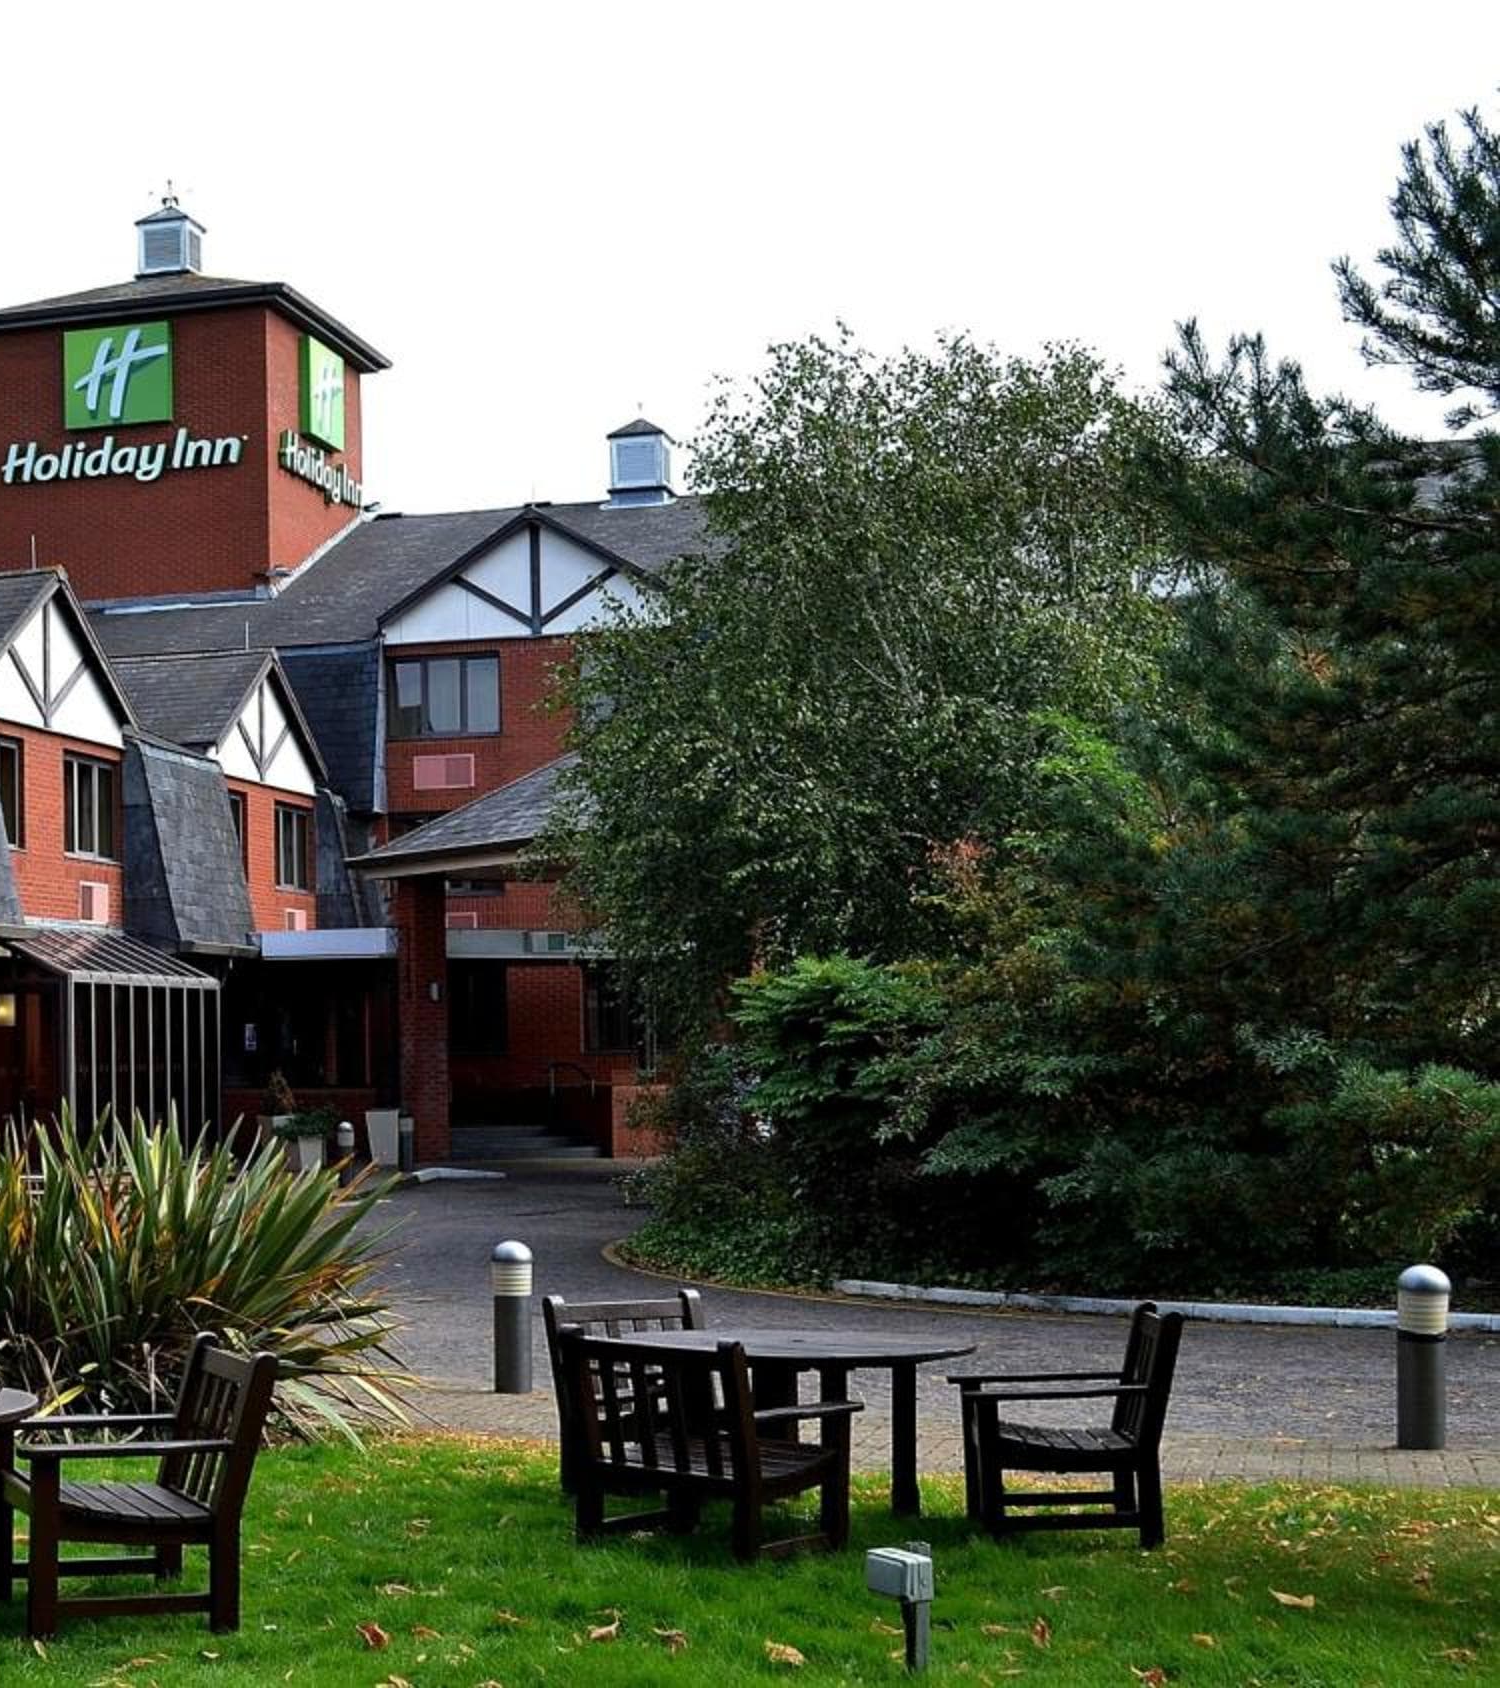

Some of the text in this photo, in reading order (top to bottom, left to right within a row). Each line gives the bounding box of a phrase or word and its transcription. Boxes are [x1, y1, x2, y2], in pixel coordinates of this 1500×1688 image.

[73, 328, 169, 418] H
[1, 427, 241, 484] Holiday Inn
[284, 428, 341, 503] Holiday
